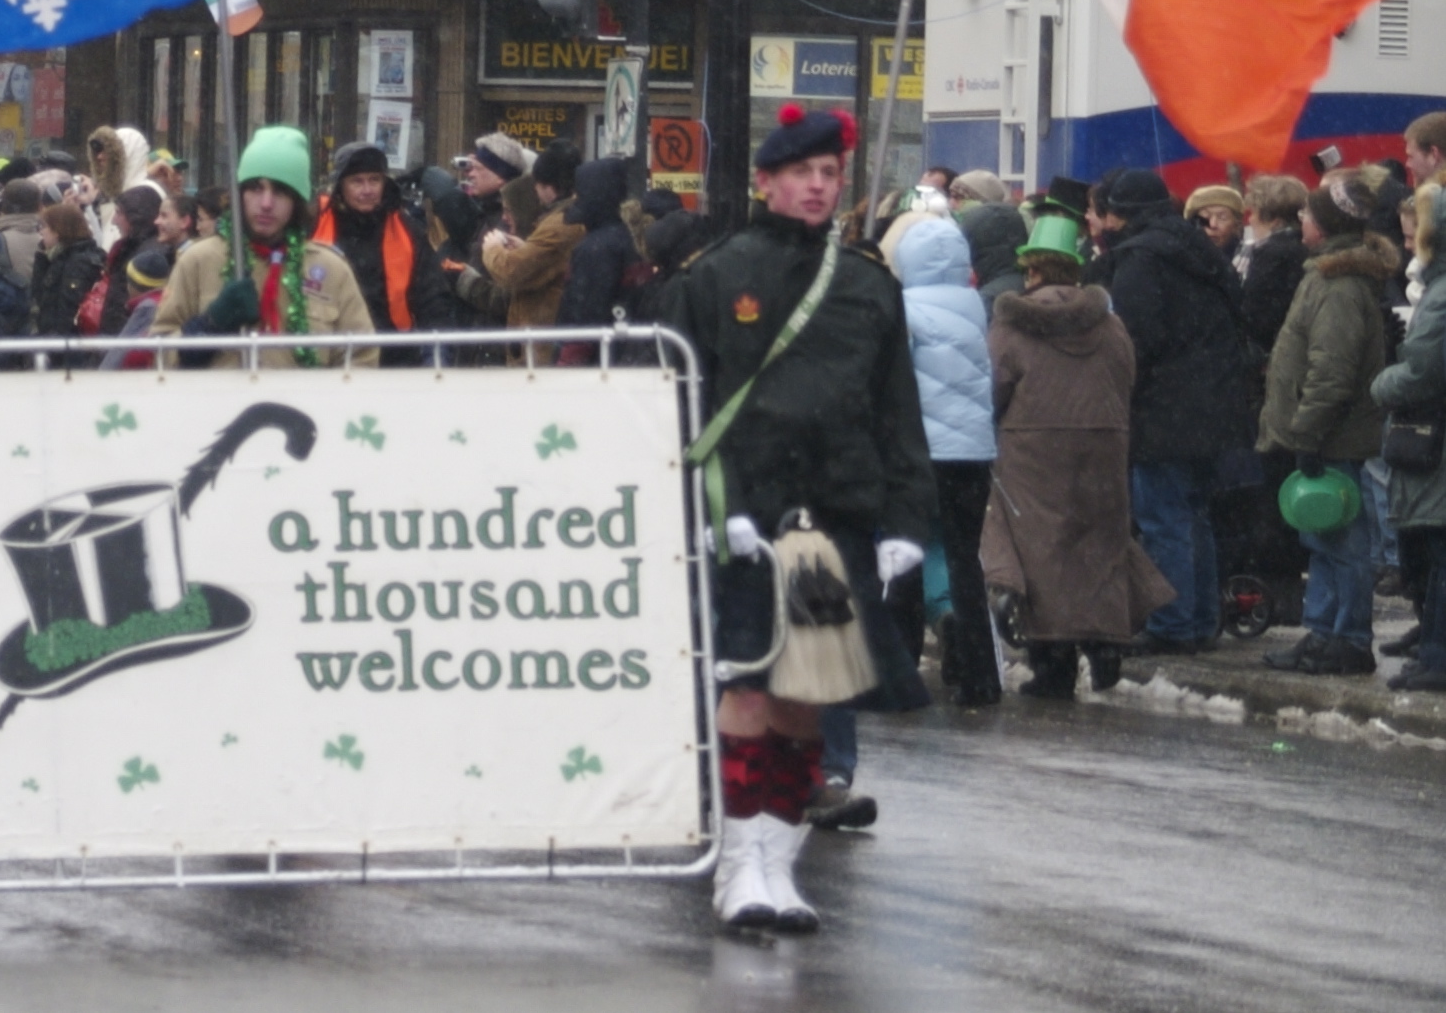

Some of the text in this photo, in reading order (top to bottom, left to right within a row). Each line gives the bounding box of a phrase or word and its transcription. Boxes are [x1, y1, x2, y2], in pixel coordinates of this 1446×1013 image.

[267, 485, 639, 553] a hundred
[294, 557, 644, 623] thousand
[295, 628, 652, 693] welcomes
